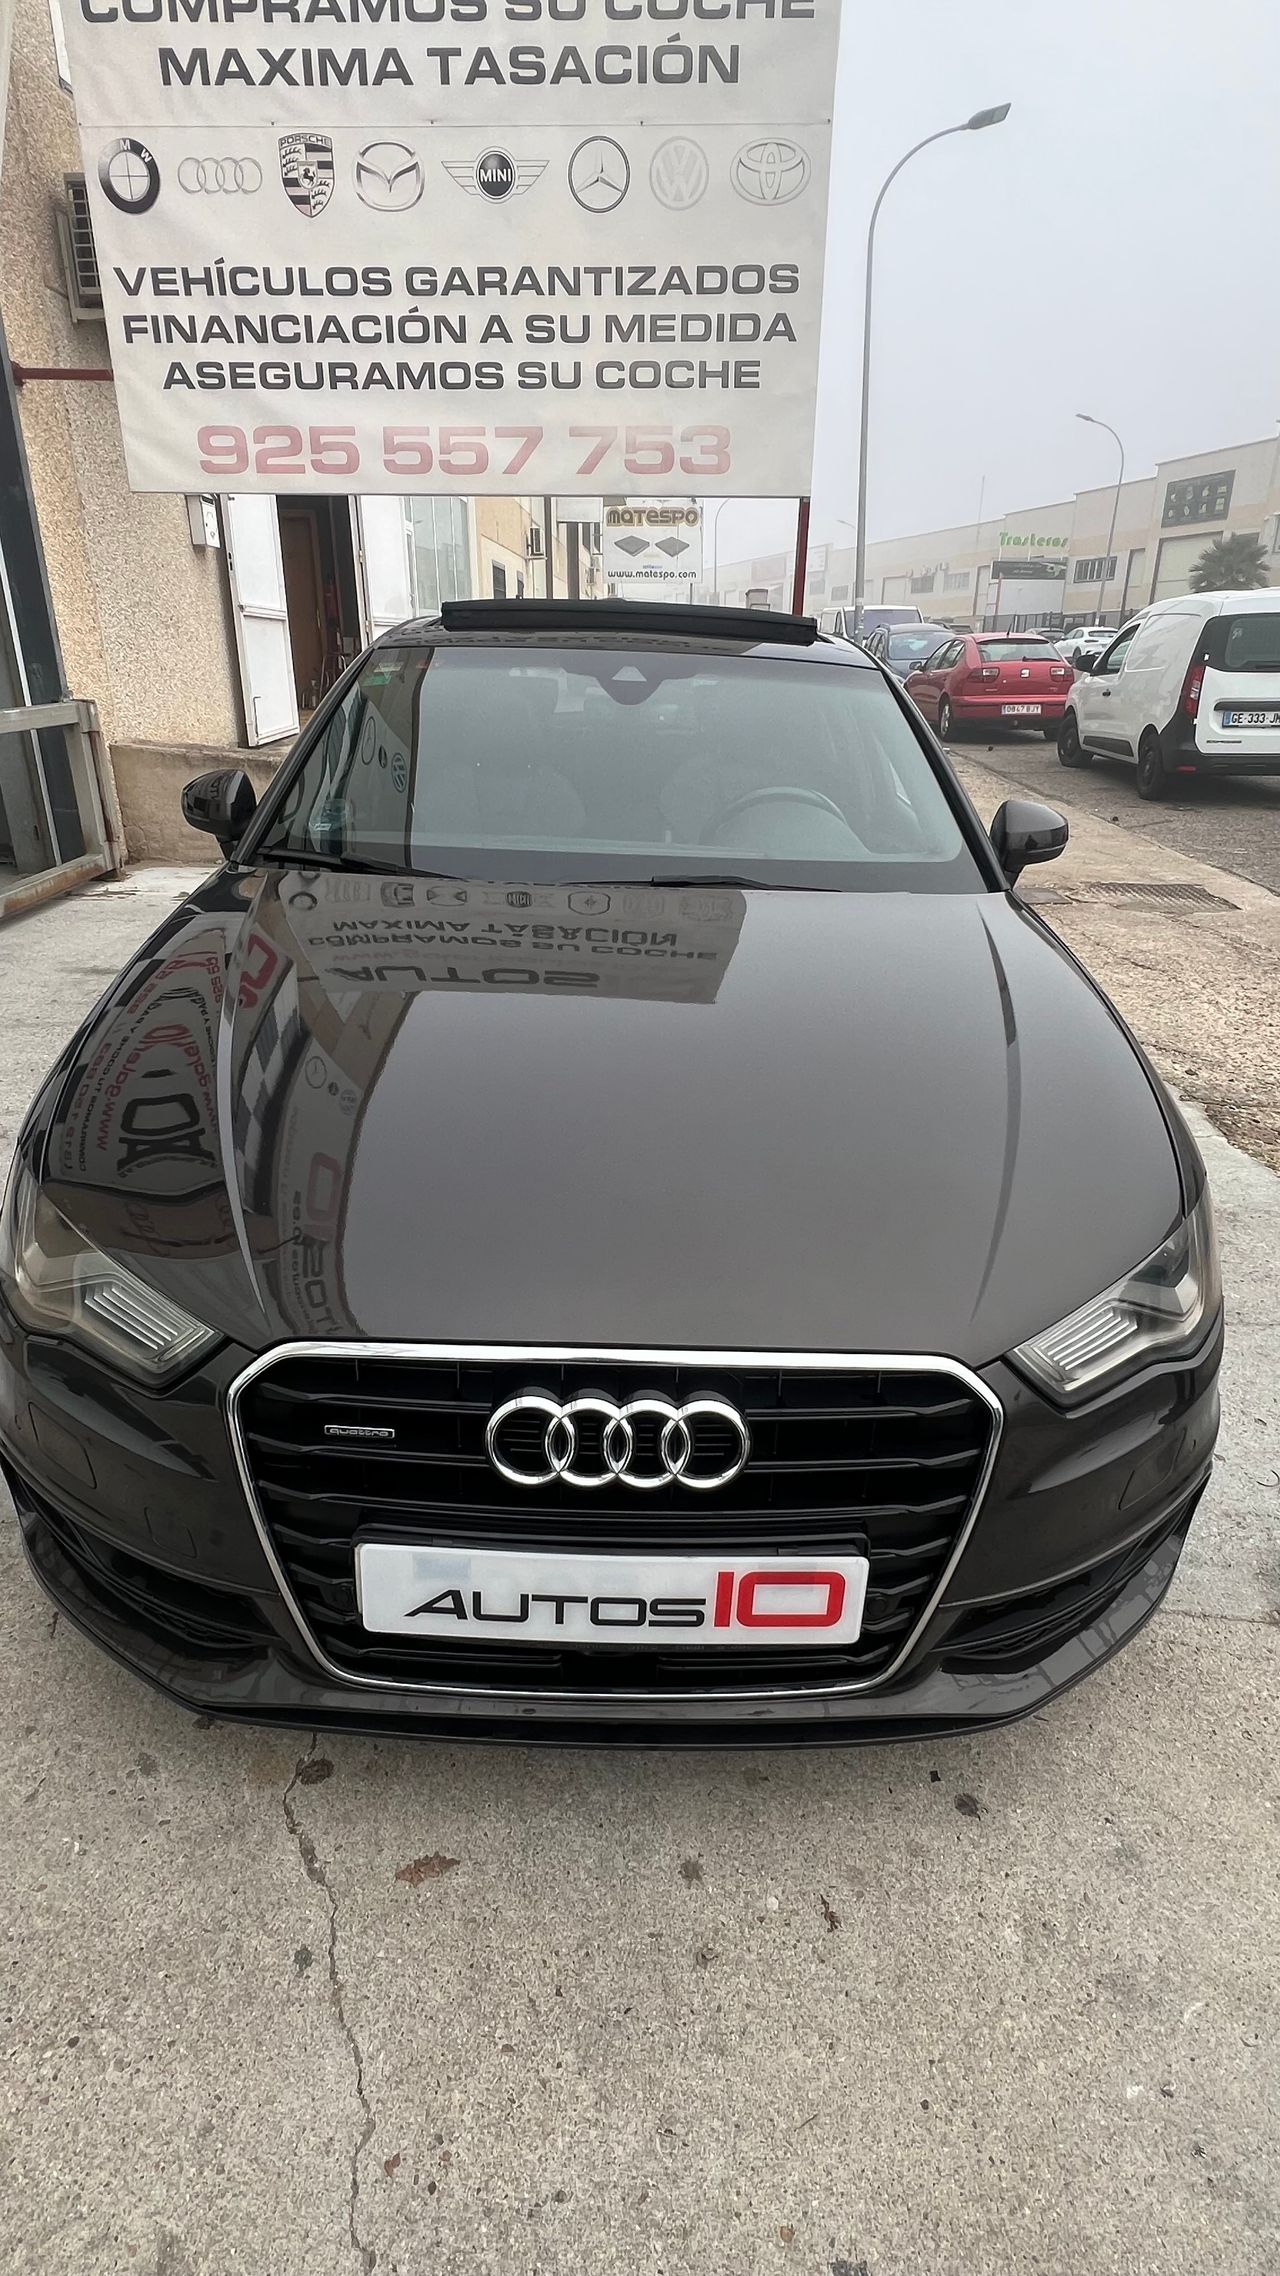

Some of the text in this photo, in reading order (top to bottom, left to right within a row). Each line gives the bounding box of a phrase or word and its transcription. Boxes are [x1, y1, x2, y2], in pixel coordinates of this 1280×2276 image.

[80, 0, 488, 22] COMPRAMOS
[504, 0, 587, 21] SU
[157, 32, 740, 86] MAXIMA TASACIÓN
[479, 167, 513, 184] MINI
[112, 256, 801, 298] VEHÍCULOS GARANTIZADOS
[123, 307, 798, 345] FINANCIACIÓN A SU MEDIDA
[162, 360, 762, 391] ASEGURAMOS SU COCHE
[198, 424, 732, 476] 925 557 753
[999, 531, 1069, 547] Trasteros
[607, 569, 697, 580] www.matespo.com
[329, 1428, 389, 1438] quattro
